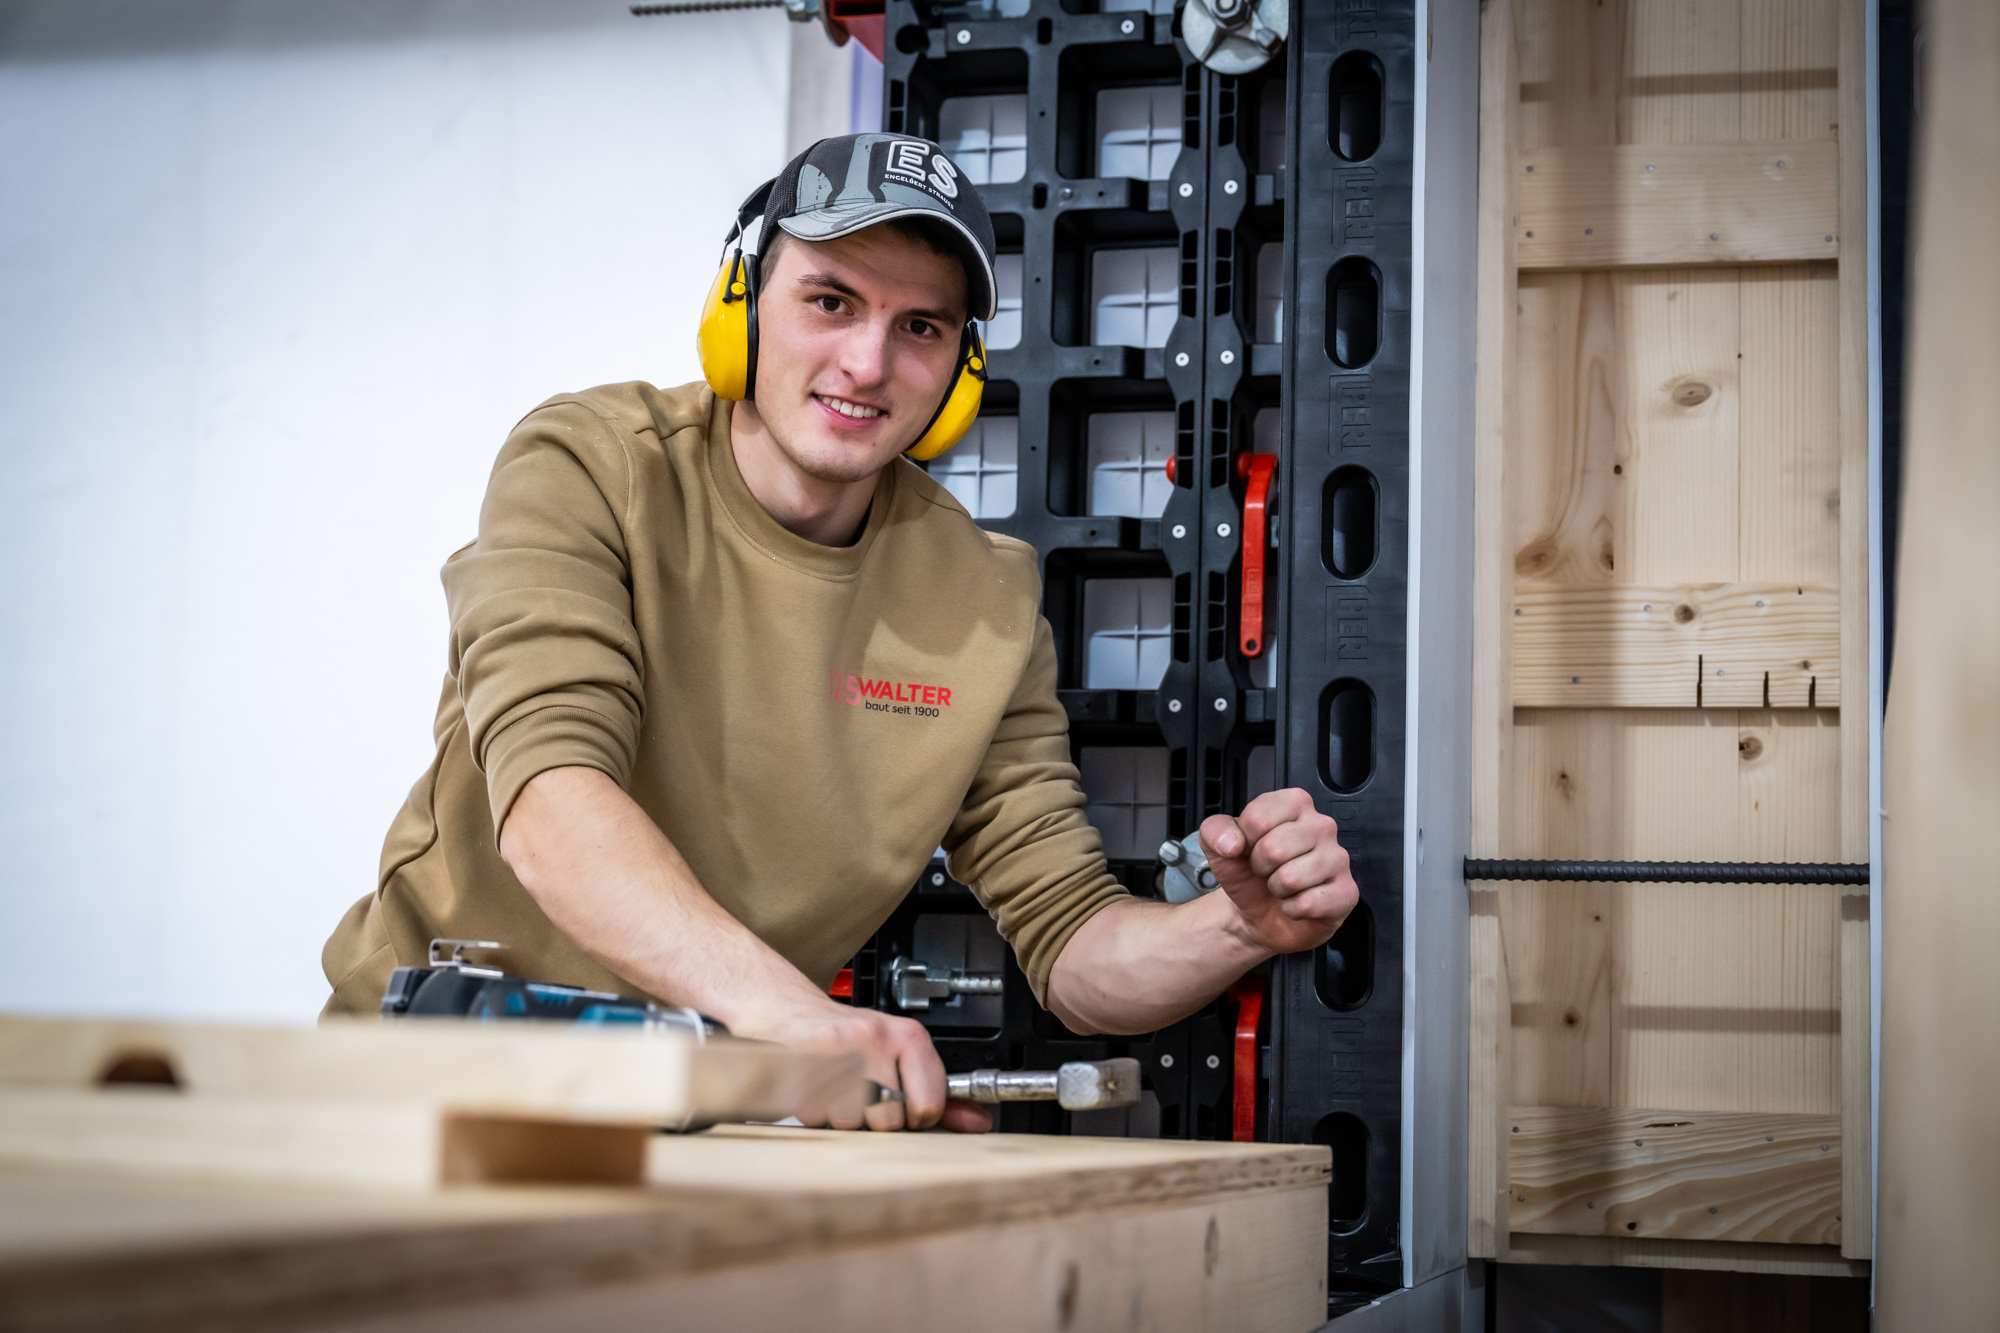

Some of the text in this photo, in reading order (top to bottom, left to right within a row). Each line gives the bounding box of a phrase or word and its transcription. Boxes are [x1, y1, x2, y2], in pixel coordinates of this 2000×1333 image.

[884, 173, 955, 210] ENGELBERT STRAUSS
[886, 140, 959, 199] ES
[1344, 178, 1376, 246] PERI
[1341, 386, 1372, 455] PERI
[1338, 597, 1369, 666] PERI
[858, 677, 952, 707] WALTER
[865, 700, 940, 718] baut seit 1900
